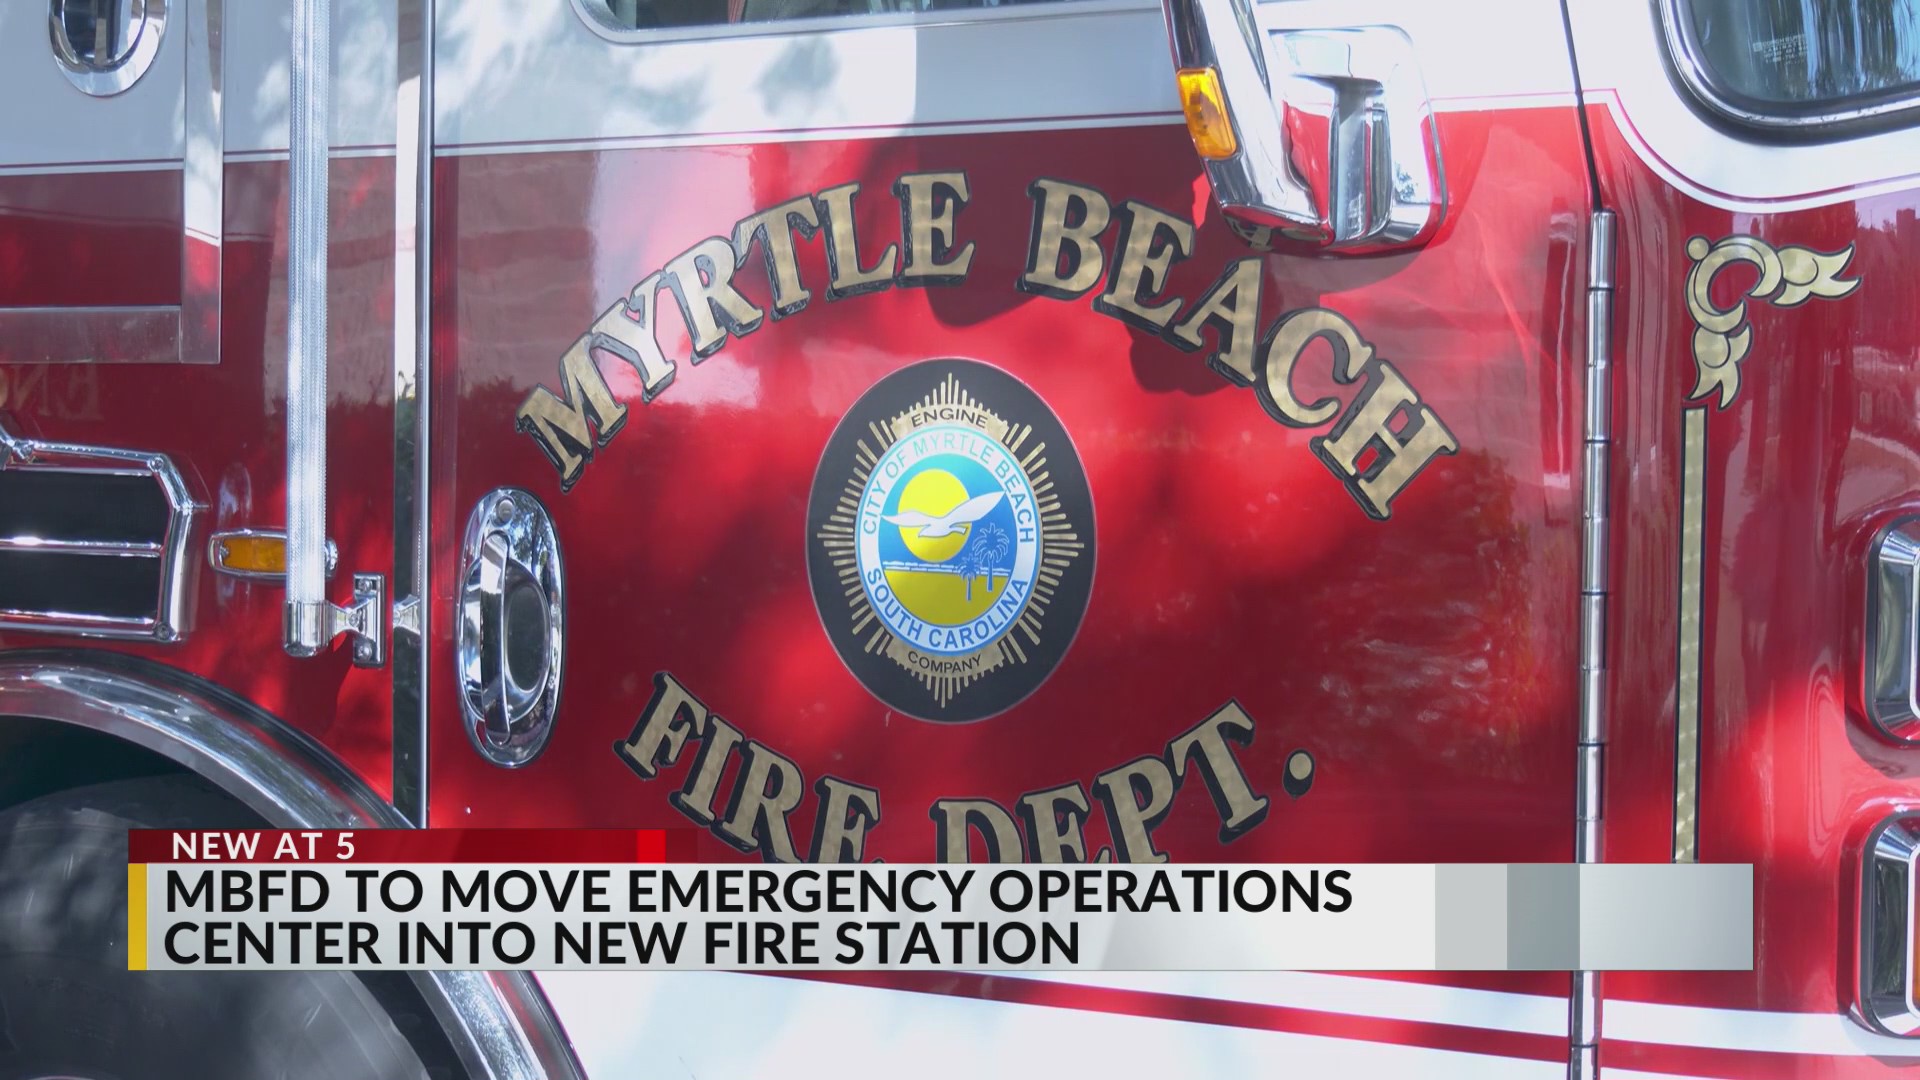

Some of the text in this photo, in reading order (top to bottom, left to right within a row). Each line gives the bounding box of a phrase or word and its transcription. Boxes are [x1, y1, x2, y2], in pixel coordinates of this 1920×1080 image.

[516, 170, 1459, 522] MYRTLE BEACH
[911, 408, 989, 429] ENGINE
[863, 431, 1035, 544] CITY OF MYRTLE BEACH
[867, 567, 1029, 649] SOUTH CAROLINA
[907, 650, 982, 674] COMPANY
[613, 671, 1316, 864] FIRE DEPT.
